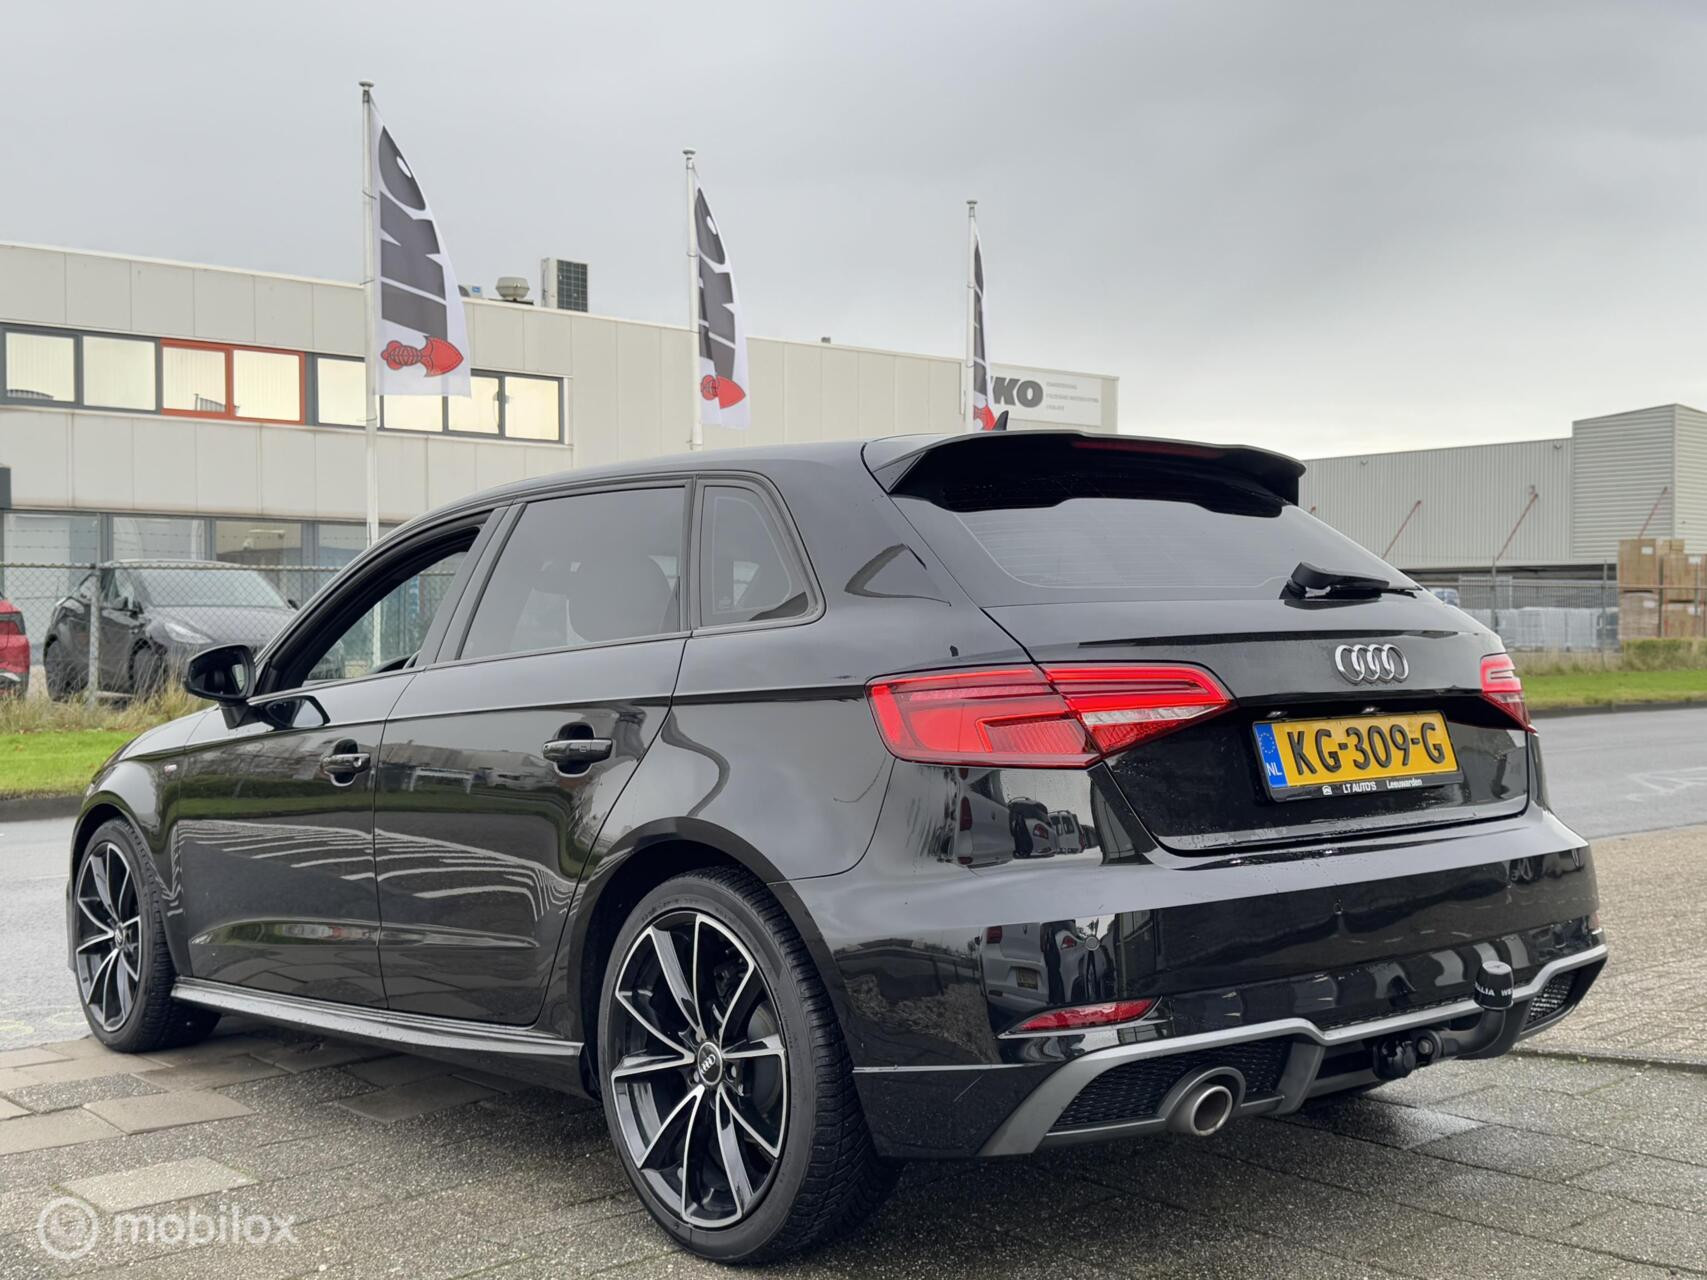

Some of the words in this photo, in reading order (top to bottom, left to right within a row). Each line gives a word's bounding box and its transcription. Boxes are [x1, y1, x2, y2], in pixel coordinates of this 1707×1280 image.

[991, 375, 1044, 408] KO
[1287, 722, 1446, 776] KG-309-G
[1267, 762, 1283, 776] NL
[1342, 783, 1352, 794] LT
